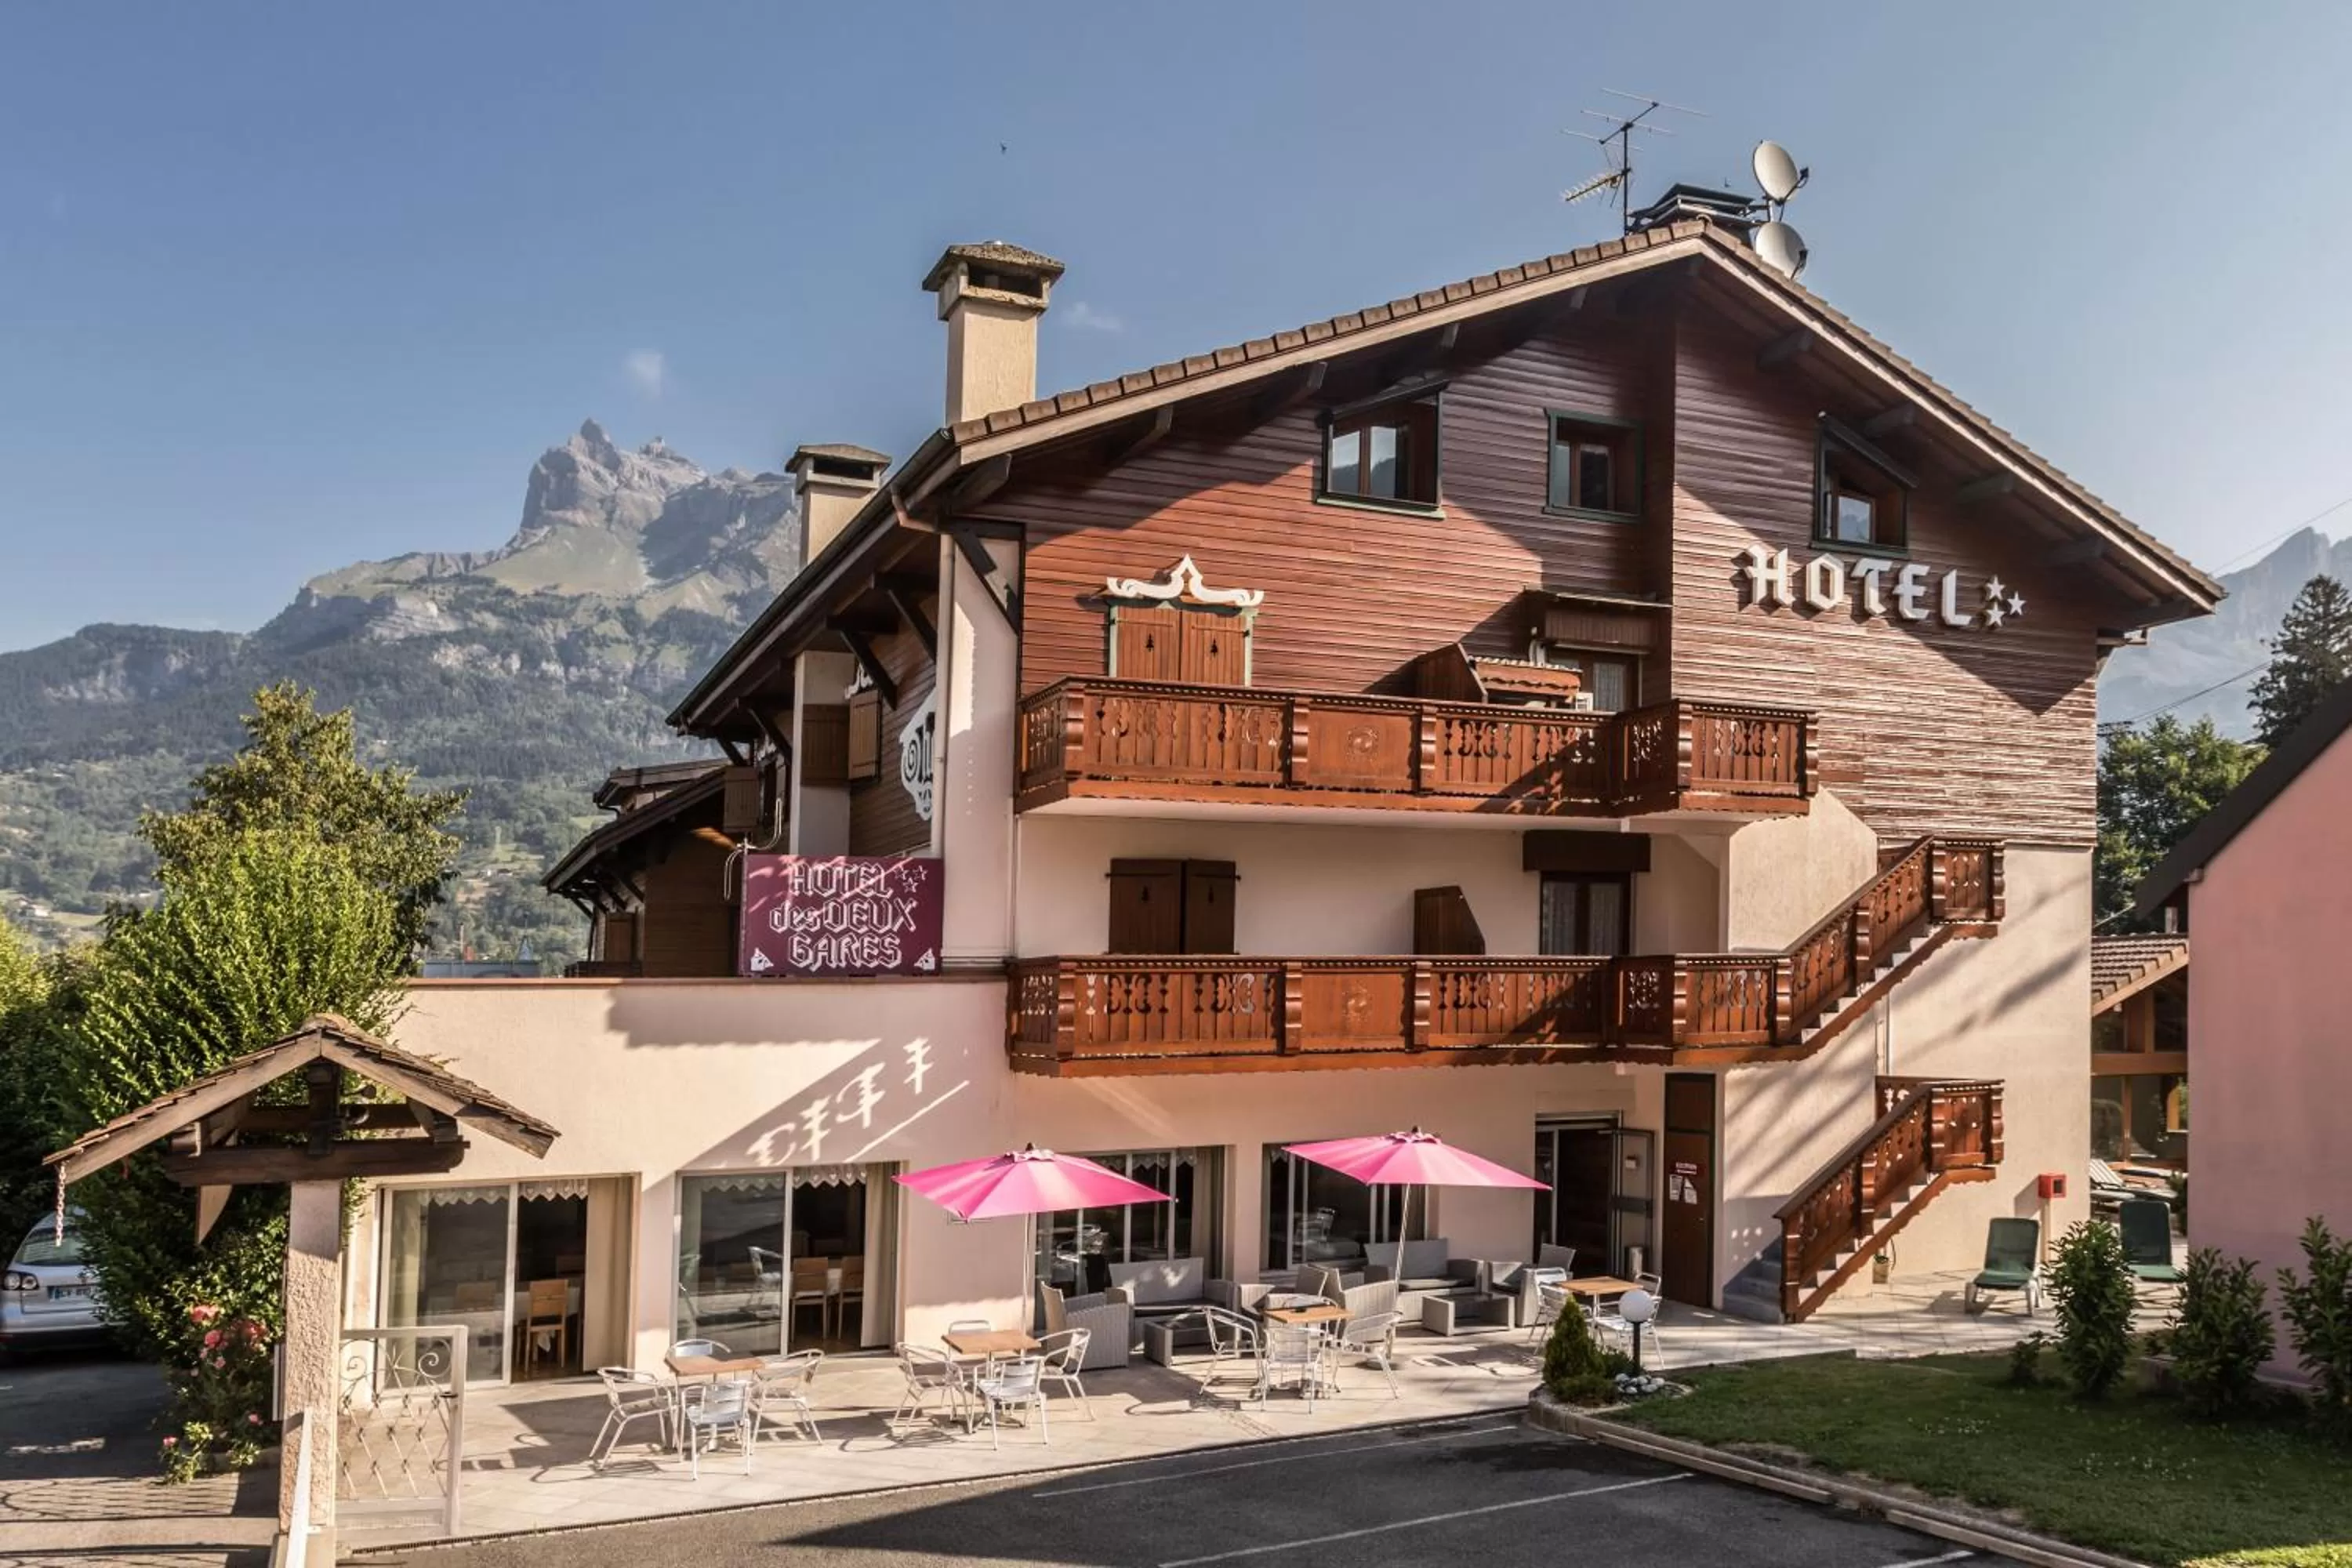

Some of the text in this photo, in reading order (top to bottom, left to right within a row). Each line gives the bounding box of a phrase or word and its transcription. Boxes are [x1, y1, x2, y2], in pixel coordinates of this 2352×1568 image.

[1744, 543, 1973, 626] HOTEL
[788, 862, 894, 898] HOTEL
[769, 898, 918, 934] des DEUX
[787, 932, 902, 972] GARES
